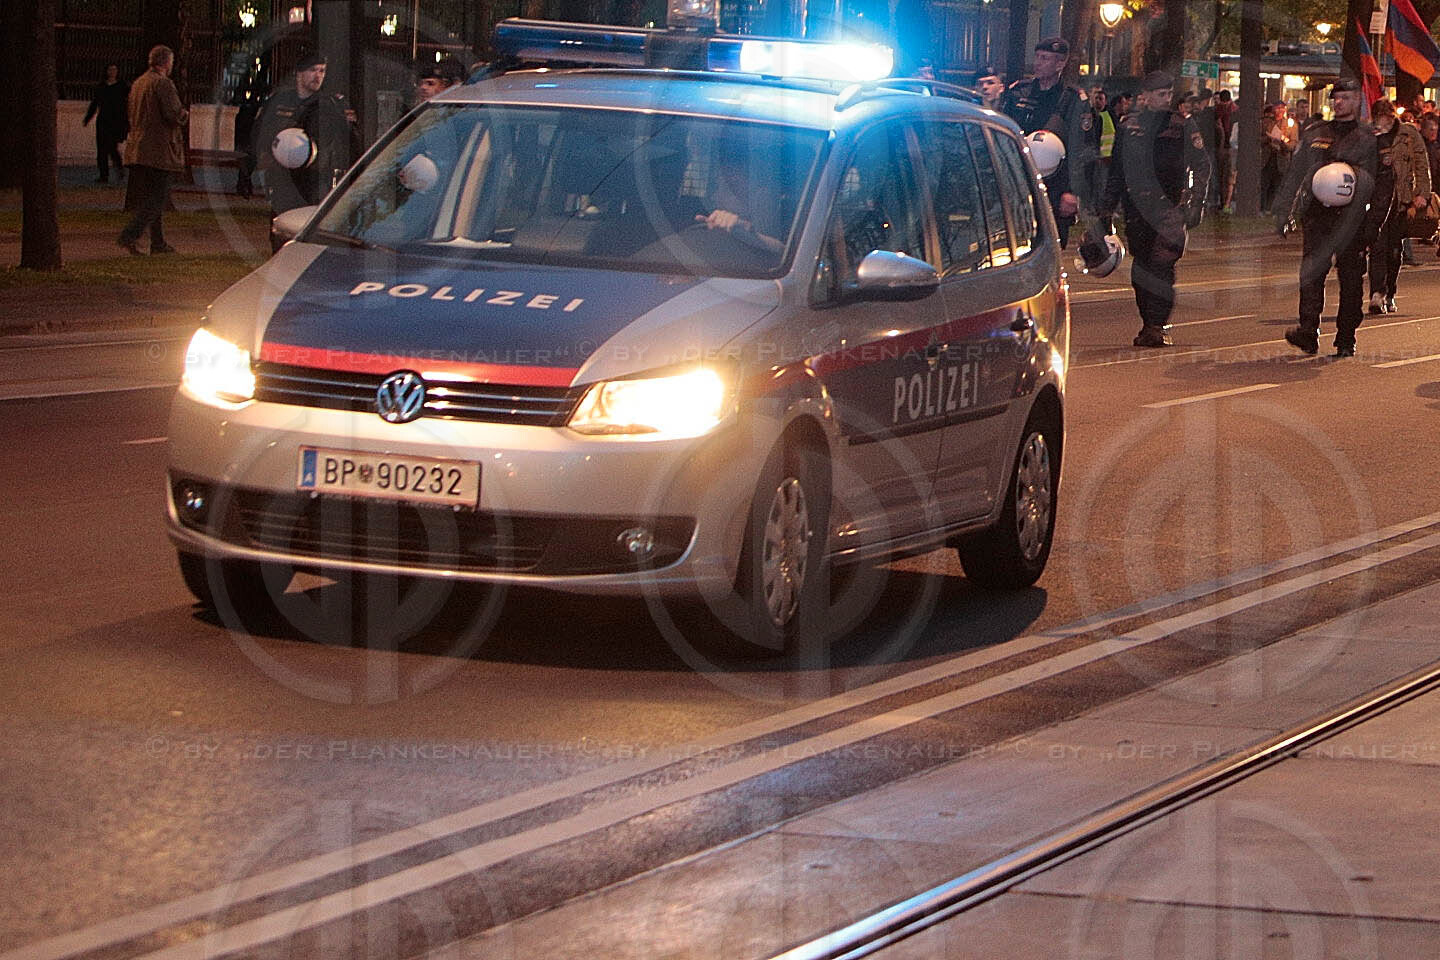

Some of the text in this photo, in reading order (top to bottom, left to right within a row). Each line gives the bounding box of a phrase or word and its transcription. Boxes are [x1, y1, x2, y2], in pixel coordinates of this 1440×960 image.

[350, 281, 584, 312] POLIZEI
[893, 361, 979, 424] POLIZEI
[324, 458, 356, 486] BP
[377, 462, 462, 495] 90232
